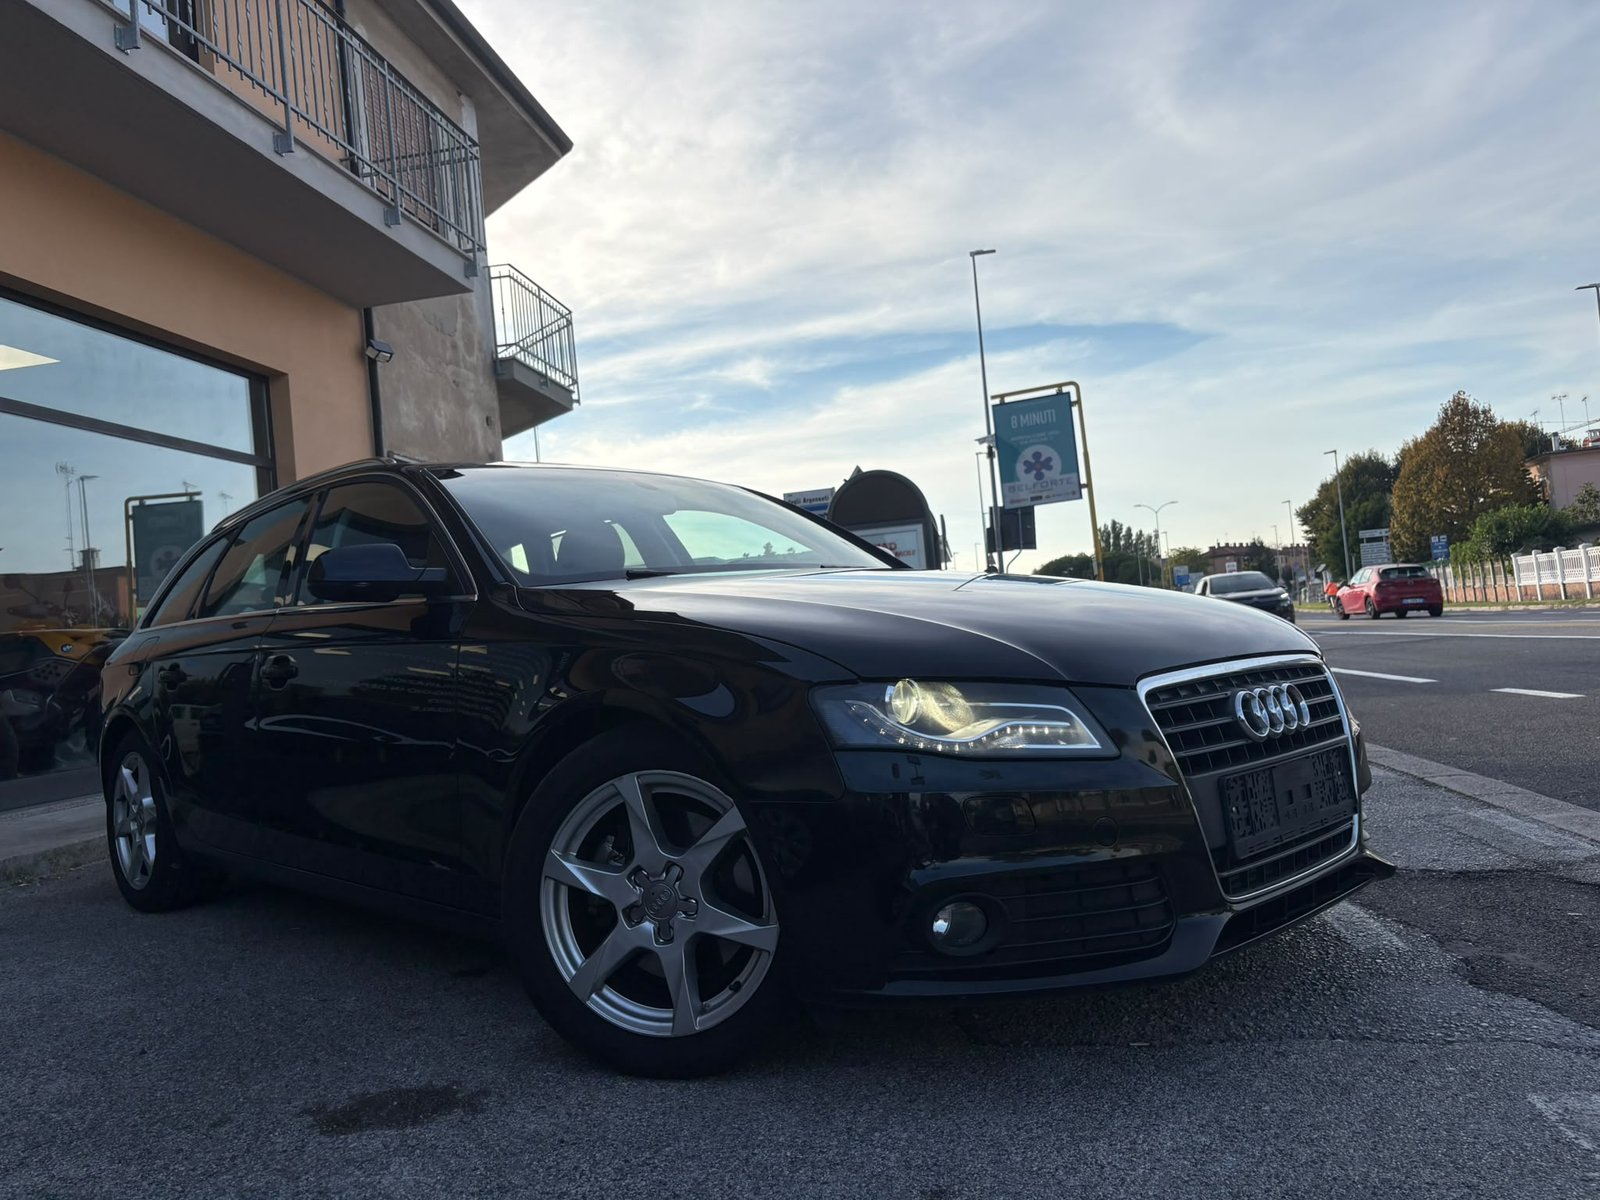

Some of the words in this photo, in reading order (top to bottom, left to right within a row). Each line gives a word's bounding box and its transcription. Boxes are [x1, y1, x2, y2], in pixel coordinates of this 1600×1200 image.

[1010, 415, 1018, 429] 8
[1020, 408, 1056, 427] MINUTI
[1008, 476, 1074, 493] BELFORTE
